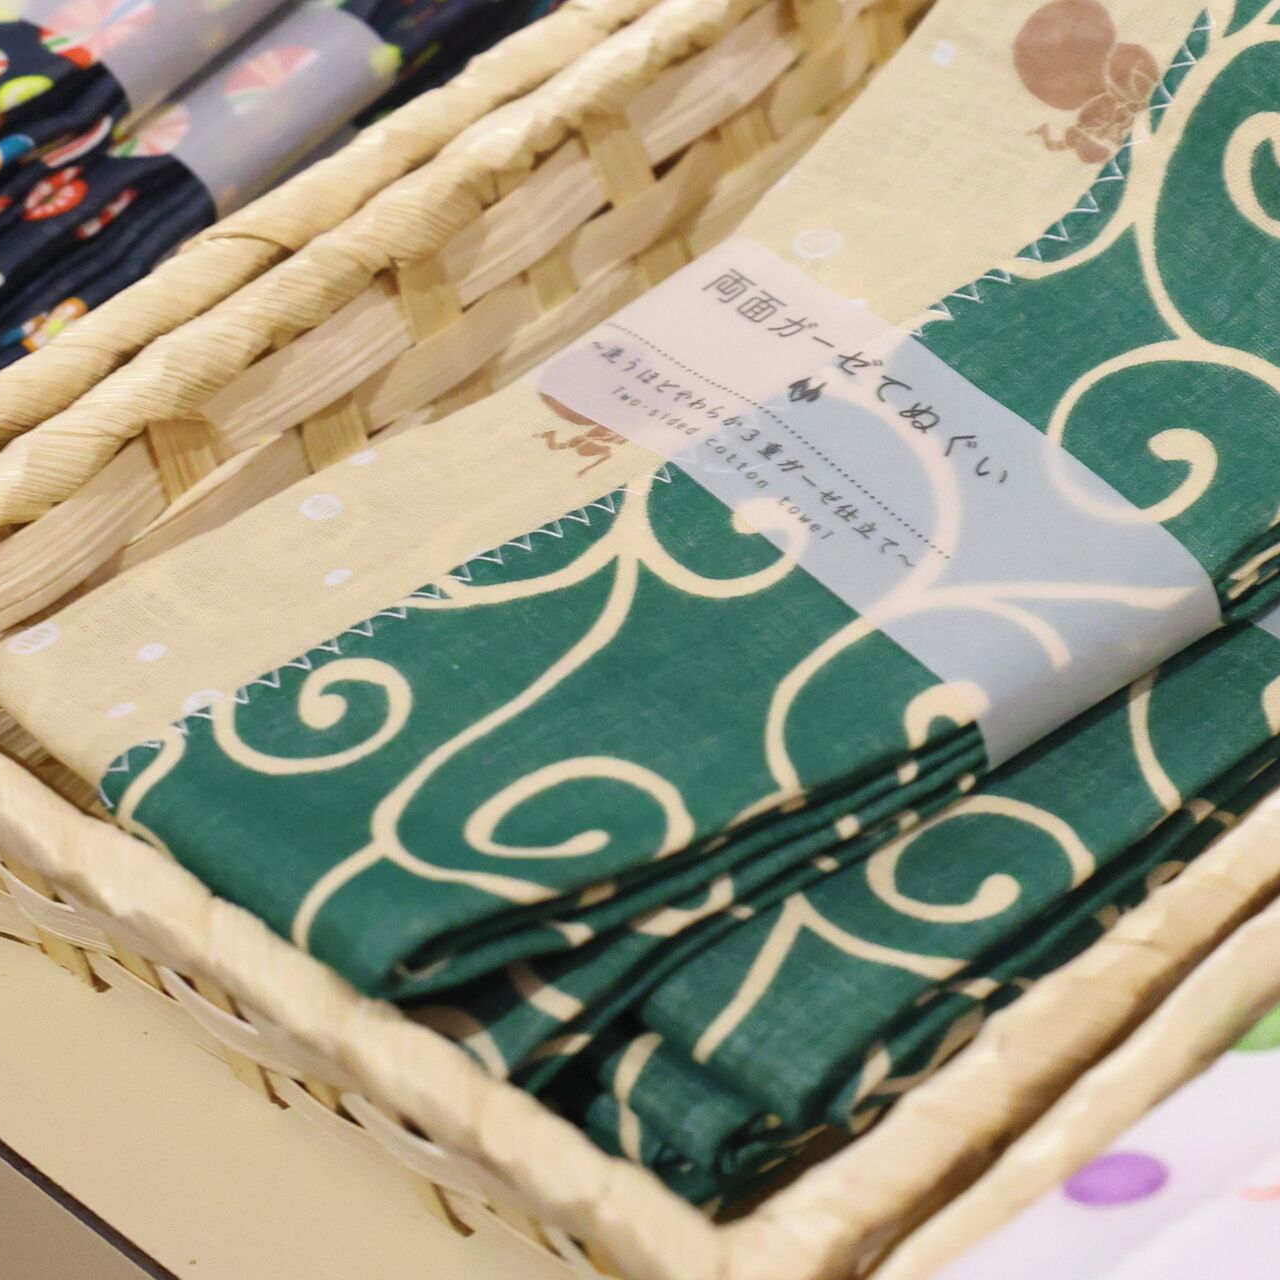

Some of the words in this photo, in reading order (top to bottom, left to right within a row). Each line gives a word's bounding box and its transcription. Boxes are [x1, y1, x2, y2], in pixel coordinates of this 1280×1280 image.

[609, 385, 702, 436] Two-sided
[704, 437, 769, 489] cotton
[778, 495, 835, 540] towel
[702, 268, 1008, 484] 両面ガーゼてぬぐい
